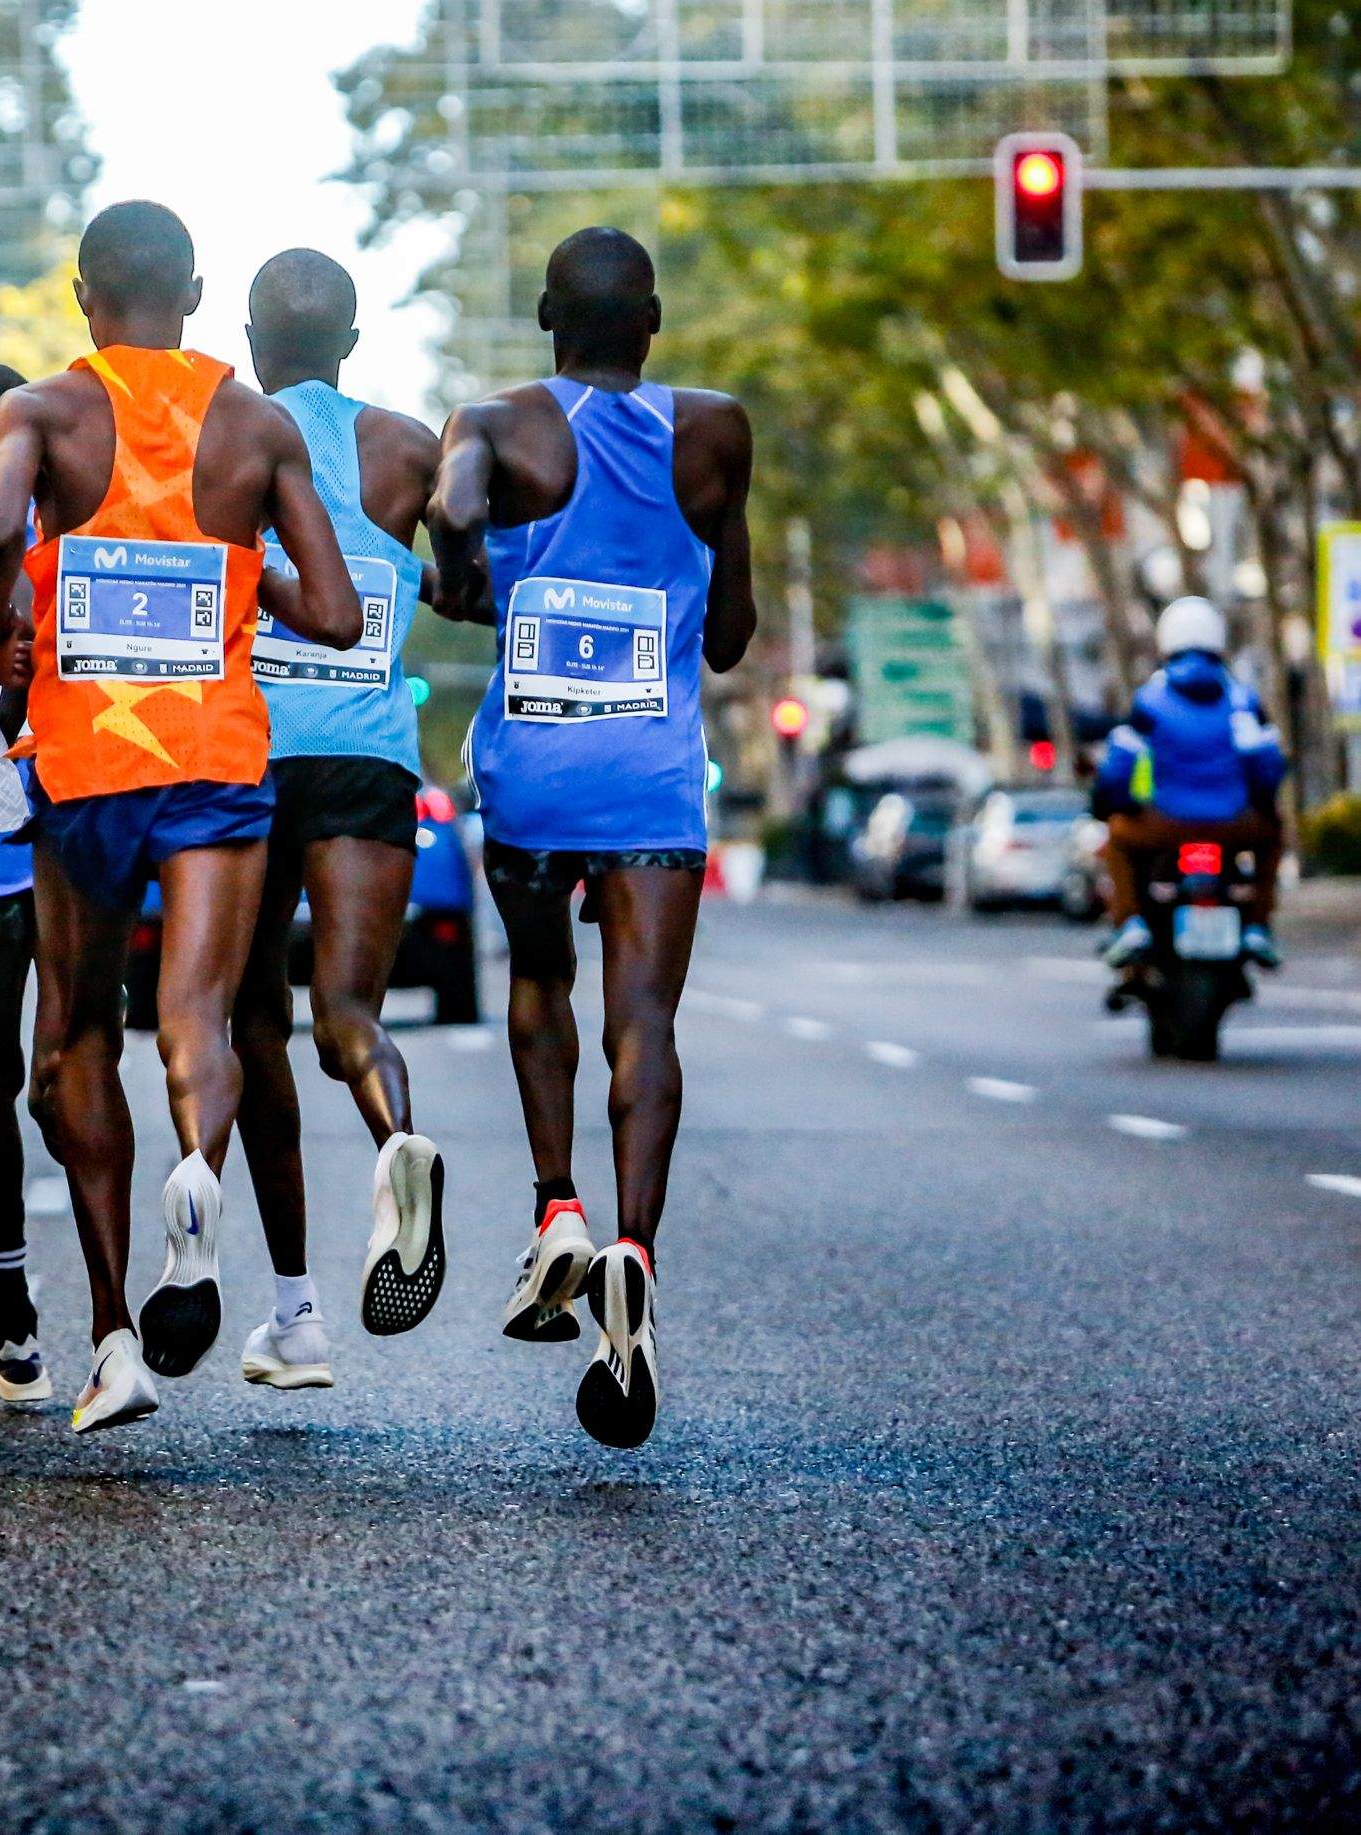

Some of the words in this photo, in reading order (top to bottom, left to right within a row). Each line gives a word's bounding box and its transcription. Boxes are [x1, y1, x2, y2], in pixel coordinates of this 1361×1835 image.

[134, 553, 191, 568] Movistar
[132, 592, 149, 616] 2
[582, 595, 633, 612] Movistar
[126, 643, 152, 653] Ngure
[579, 634, 594, 659] 6
[296, 648, 327, 659] Karanja
[172, 663, 214, 673] MADRID
[341, 670, 381, 680] MADRID
[567, 685, 601, 696] Kipketer
[617, 701, 658, 711] MADRID
